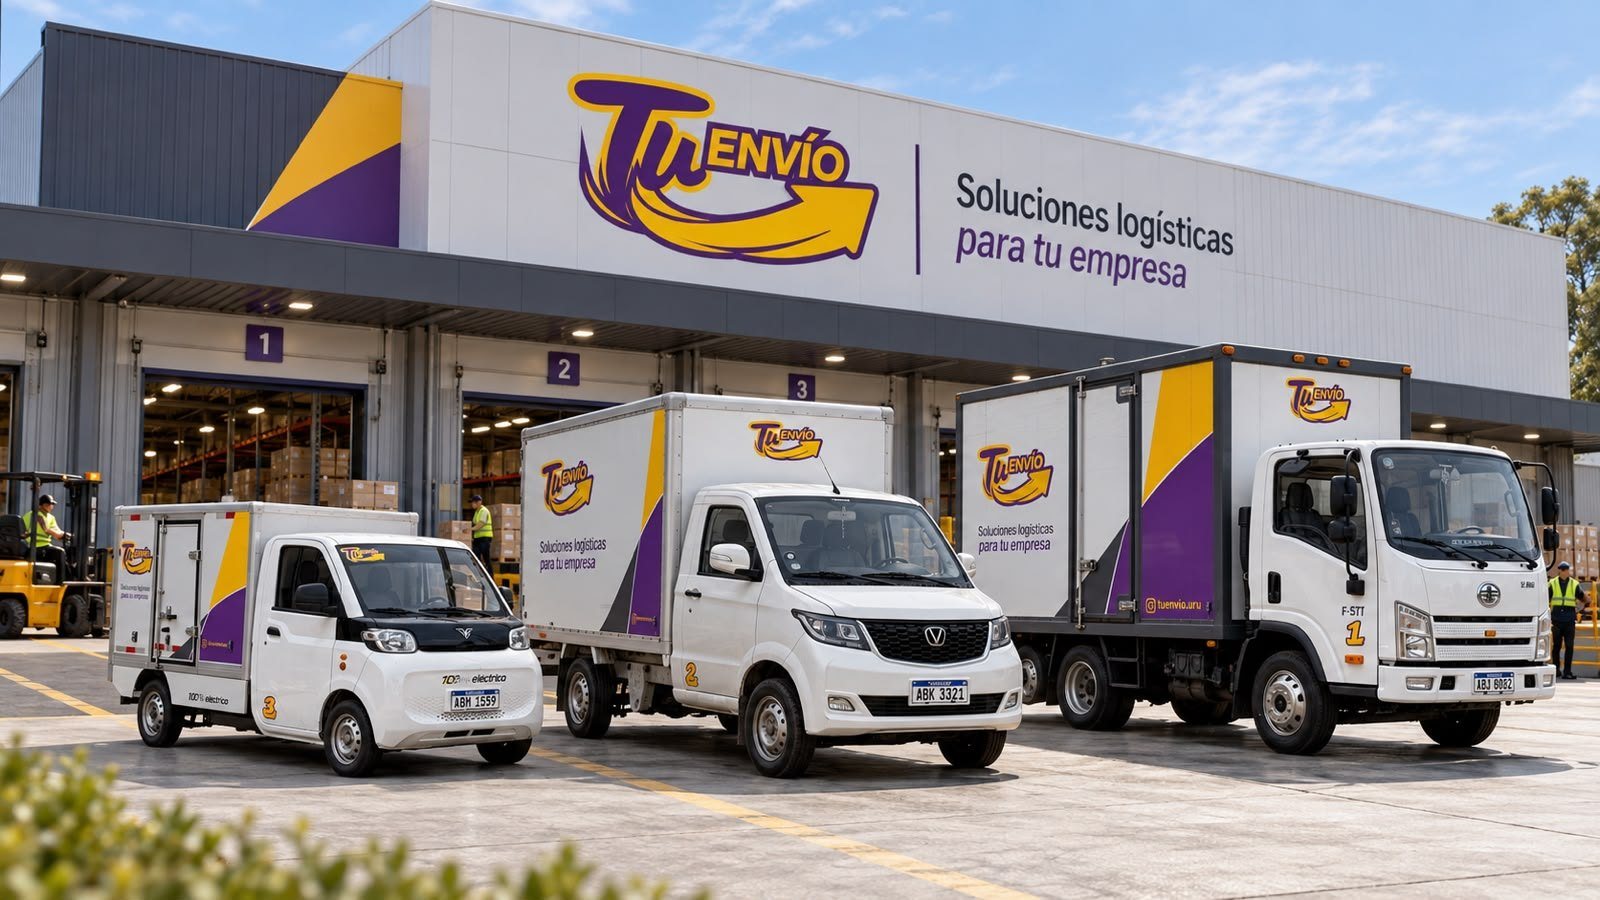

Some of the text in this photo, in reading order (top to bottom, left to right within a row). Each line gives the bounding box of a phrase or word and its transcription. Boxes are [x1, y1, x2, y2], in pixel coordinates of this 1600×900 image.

[568, 73, 849, 212] Tu ENVÍO
[956, 172, 1234, 256] Soluciones logísticas
[955, 226, 1188, 289] para tu empresa
[259, 332, 270, 355] 1
[558, 358, 571, 380] 2
[796, 379, 808, 400] 3
[1313, 384, 1344, 401] ENVÍO
[780, 427, 815, 441] ENVÍO
[1007, 449, 1046, 474] ENVÍO
[978, 524, 1017, 538] Soluciones
[540, 540, 573, 554] Soluciones
[978, 538, 1051, 556] para tu empresa
[540, 556, 596, 574] para tu empresa
[1157, 598, 1202, 610] tuenvio.uru
[1345, 620, 1366, 647] 1
[685, 661, 699, 687] 2
[475, 695, 497, 708] 1559
[916, 687, 965, 701] ABK 3321
[262, 695, 278, 721] 3
